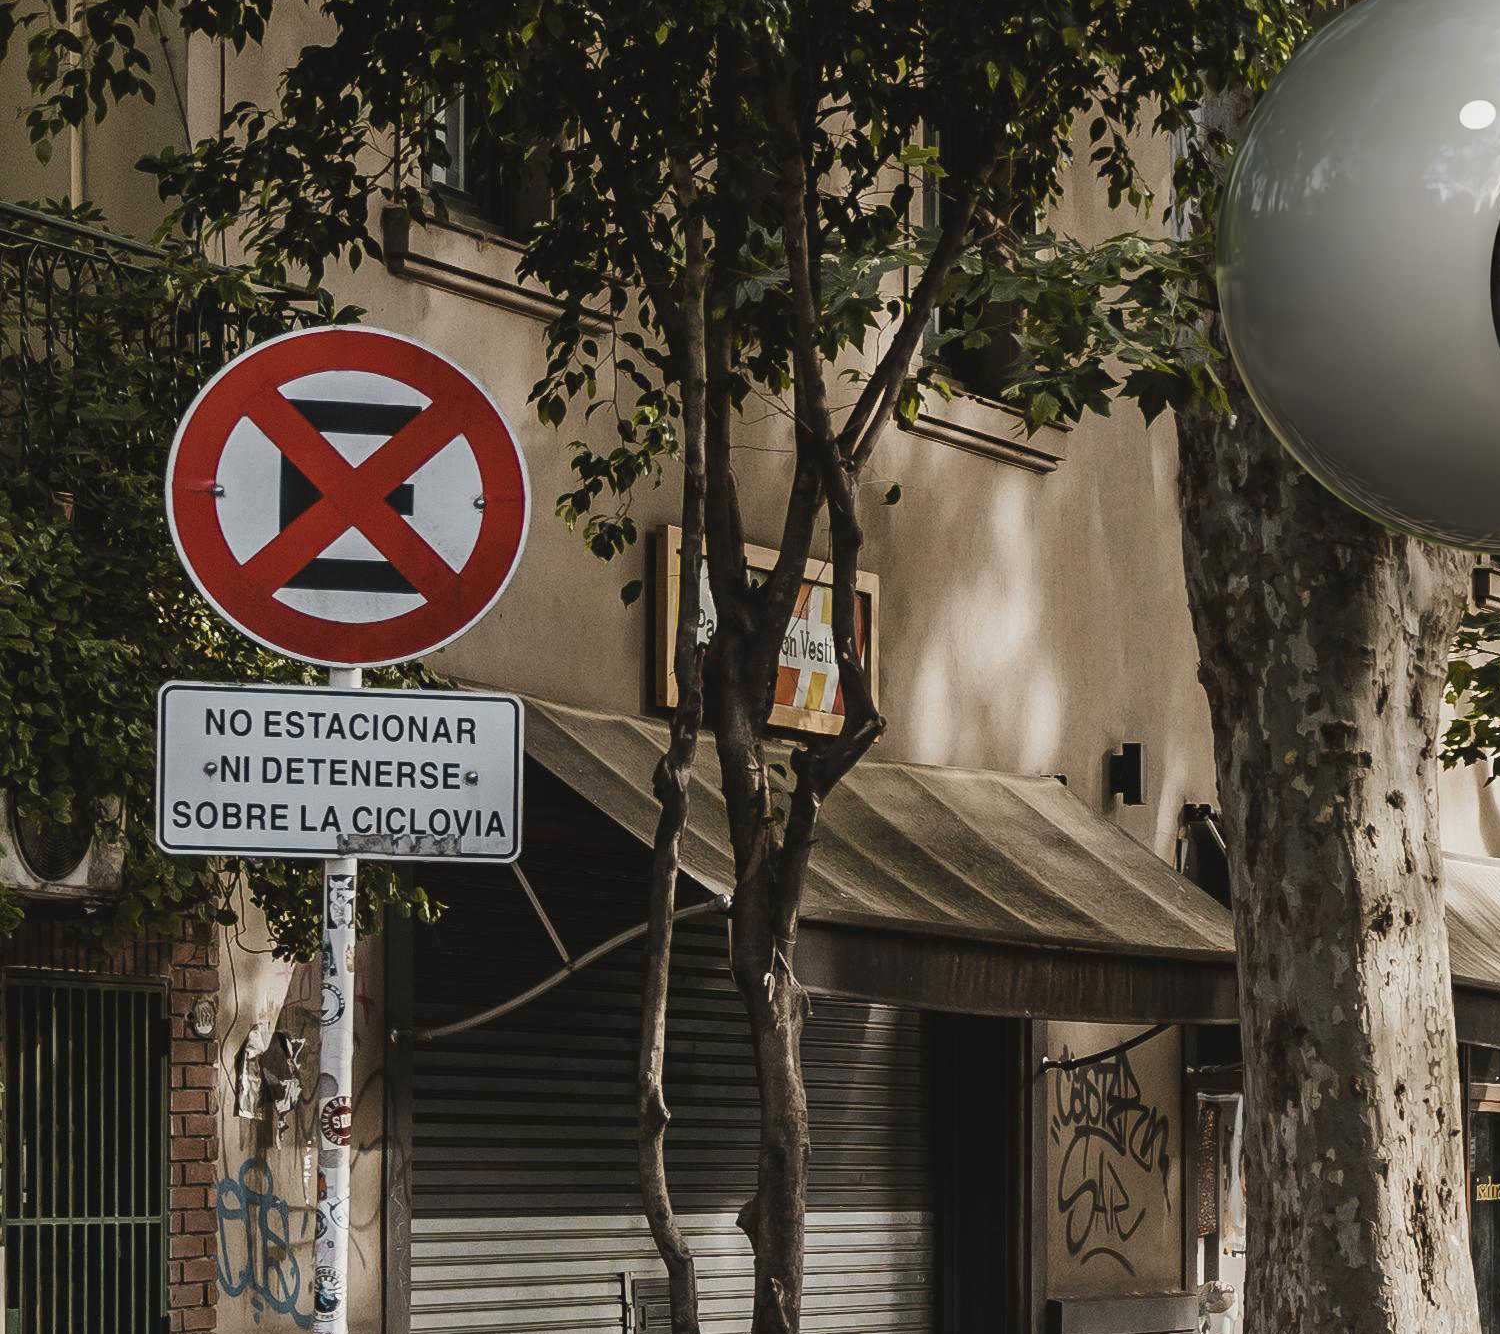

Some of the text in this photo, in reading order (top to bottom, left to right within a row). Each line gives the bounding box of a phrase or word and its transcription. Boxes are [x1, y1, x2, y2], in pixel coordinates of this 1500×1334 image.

[800, 630, 837, 665] Vesti
[206, 708, 477, 745] NO ESTACIONAR
[220, 755, 461, 790] NI DETENERSE
[172, 800, 506, 838] SOBRE LA CICLOVIA
